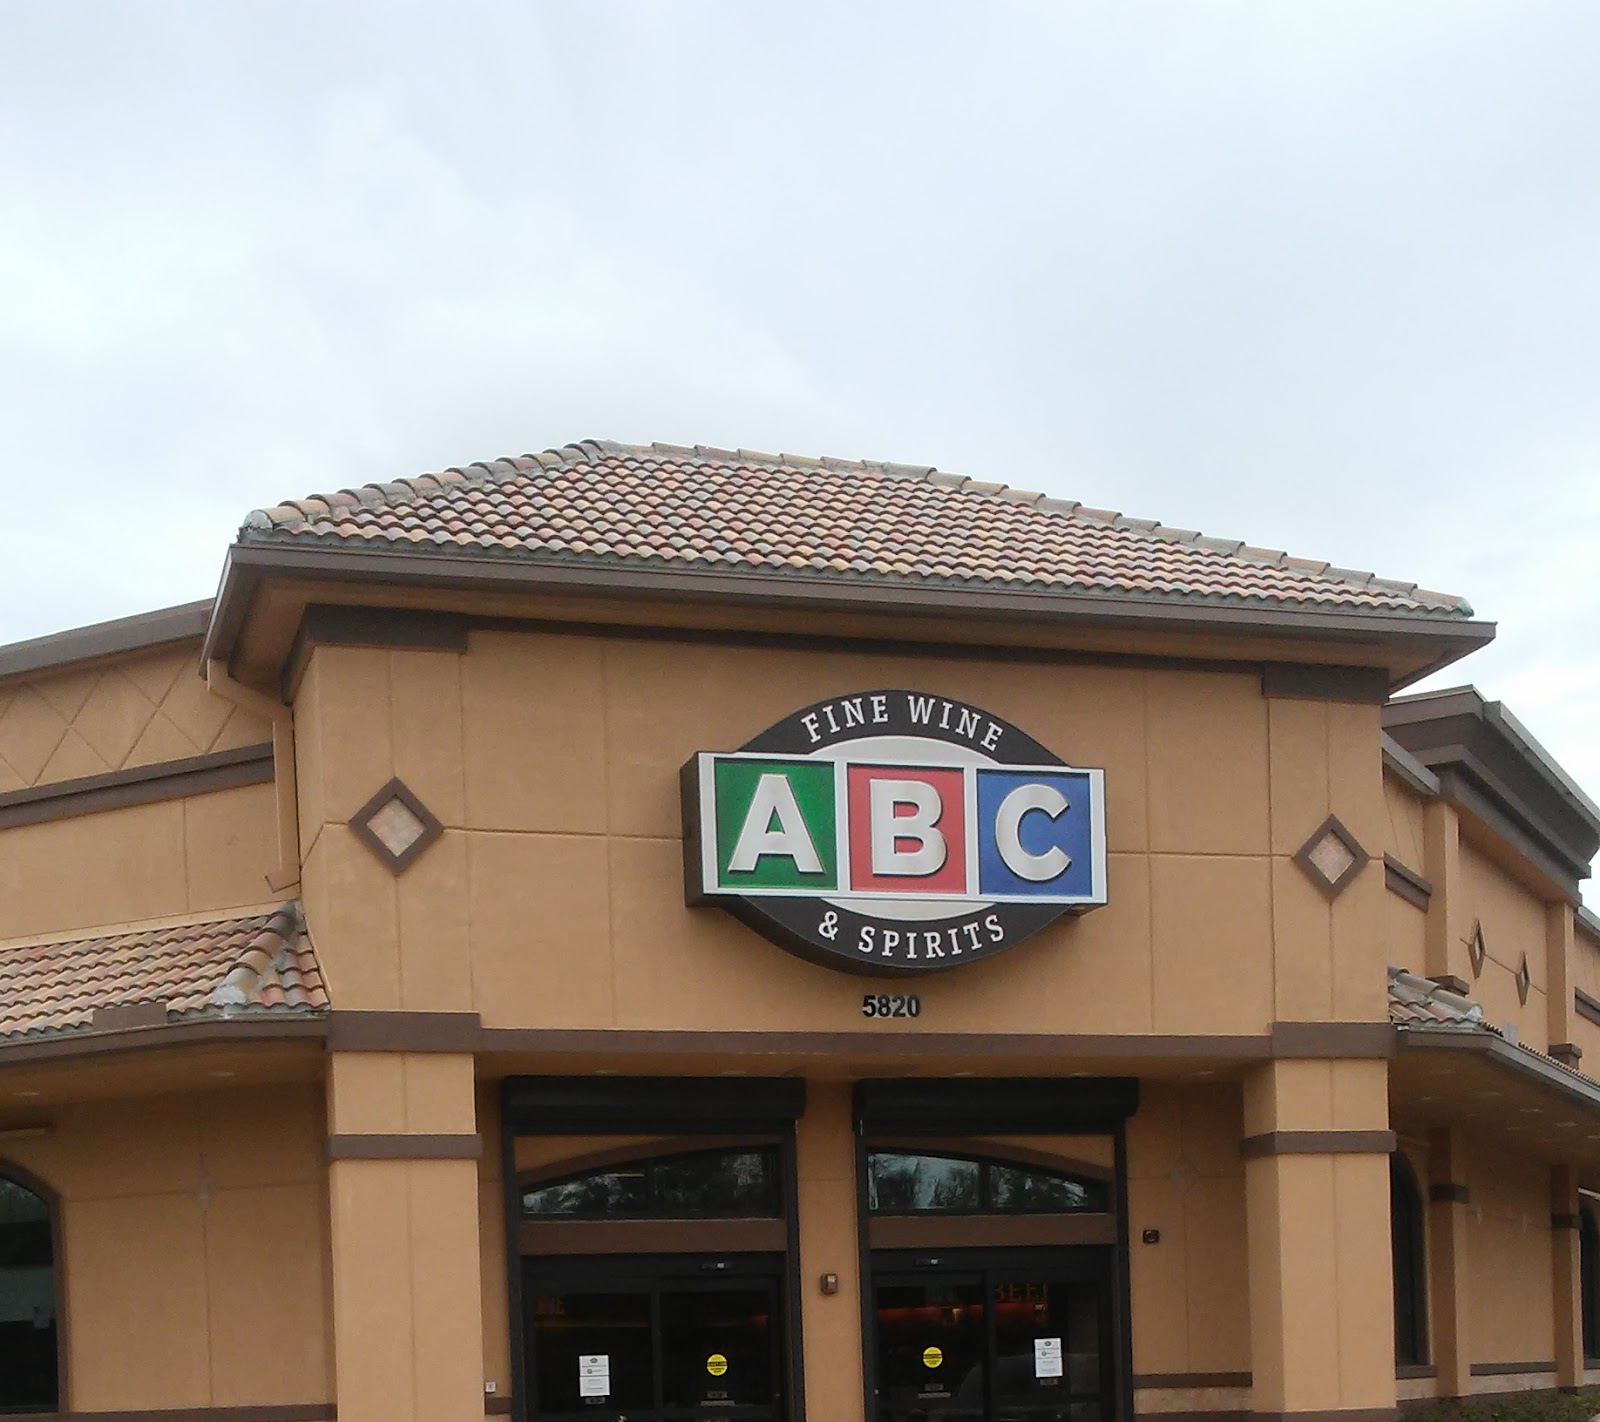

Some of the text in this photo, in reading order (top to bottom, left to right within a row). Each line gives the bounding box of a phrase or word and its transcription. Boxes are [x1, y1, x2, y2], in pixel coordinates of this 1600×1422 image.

[801, 695, 1004, 752] FINE WINE
[727, 773, 1072, 881] ABC
[818, 911, 1005, 960] & SPIRITS
[862, 994, 921, 1018] 5820
